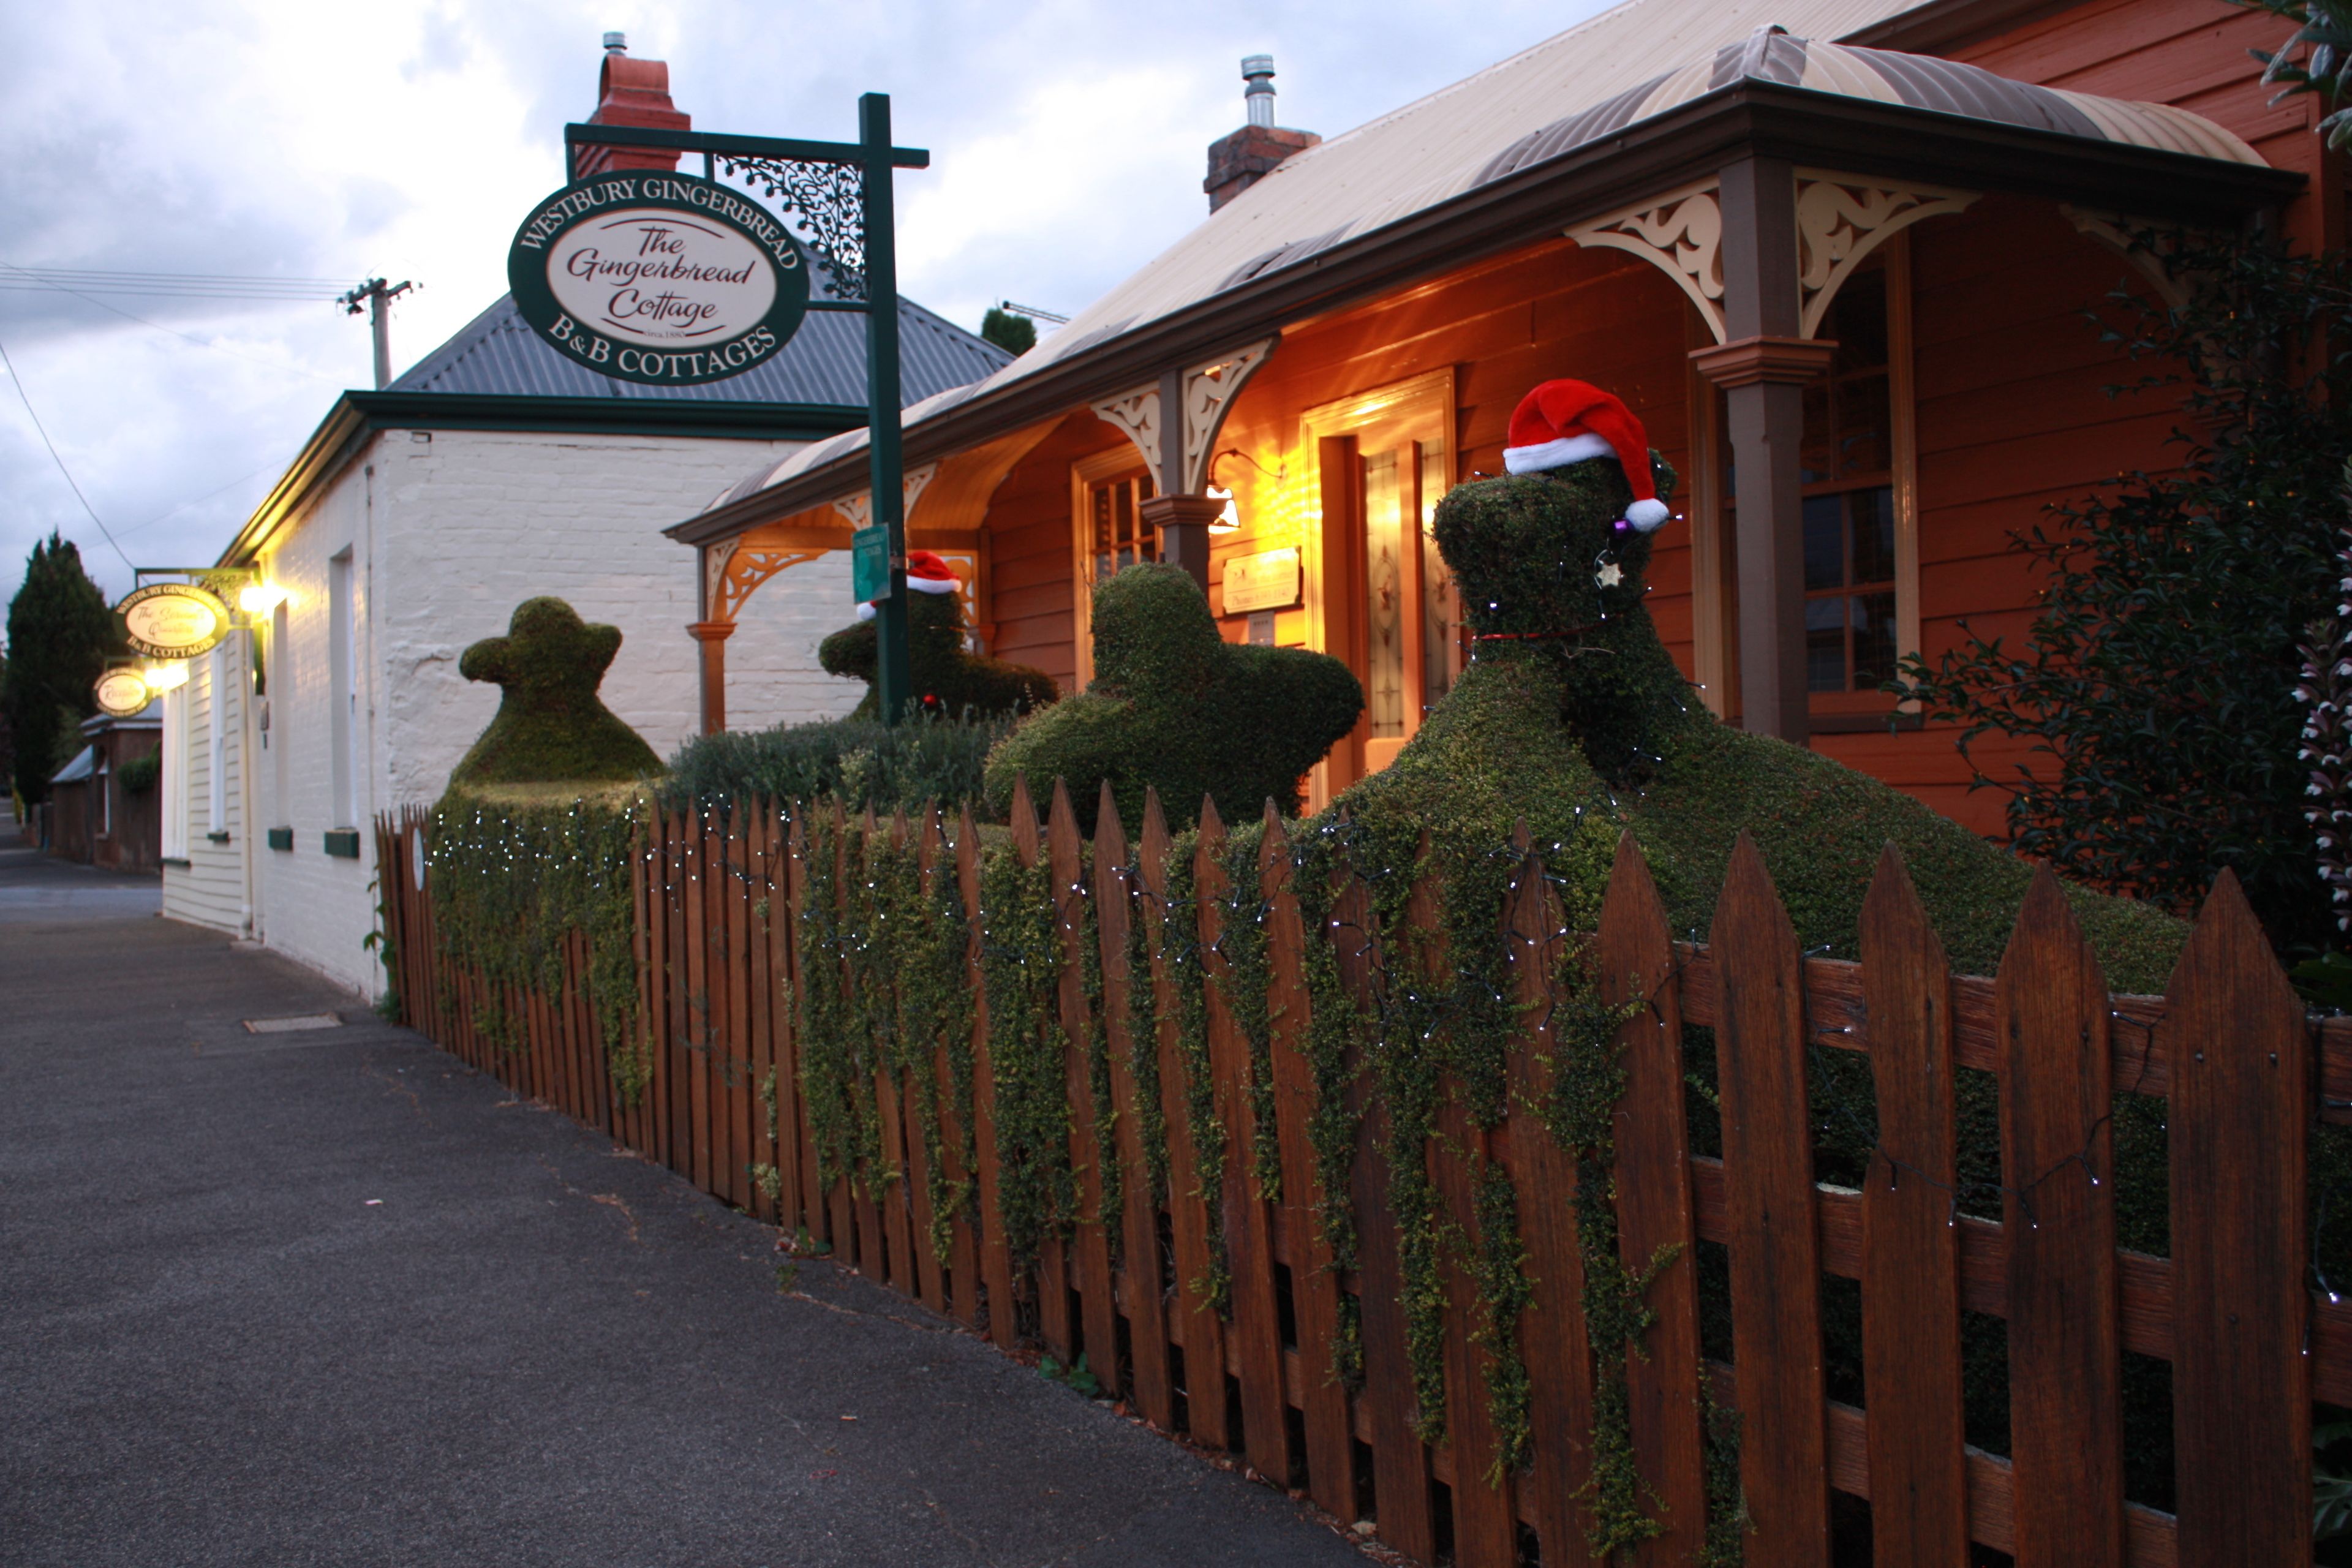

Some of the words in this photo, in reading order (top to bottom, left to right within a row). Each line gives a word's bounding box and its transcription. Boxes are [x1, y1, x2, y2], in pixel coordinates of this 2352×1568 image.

[521, 179, 636, 251] WESTBURY
[643, 179, 798, 270] GINGERBREAD
[638, 226, 686, 257] The
[567, 248, 756, 286] Gingerbread
[608, 288, 718, 328] Cottage
[618, 325, 776, 378] COTTAGES
[138, 606, 153, 620] The
[153, 638, 216, 658] COTTAGES
